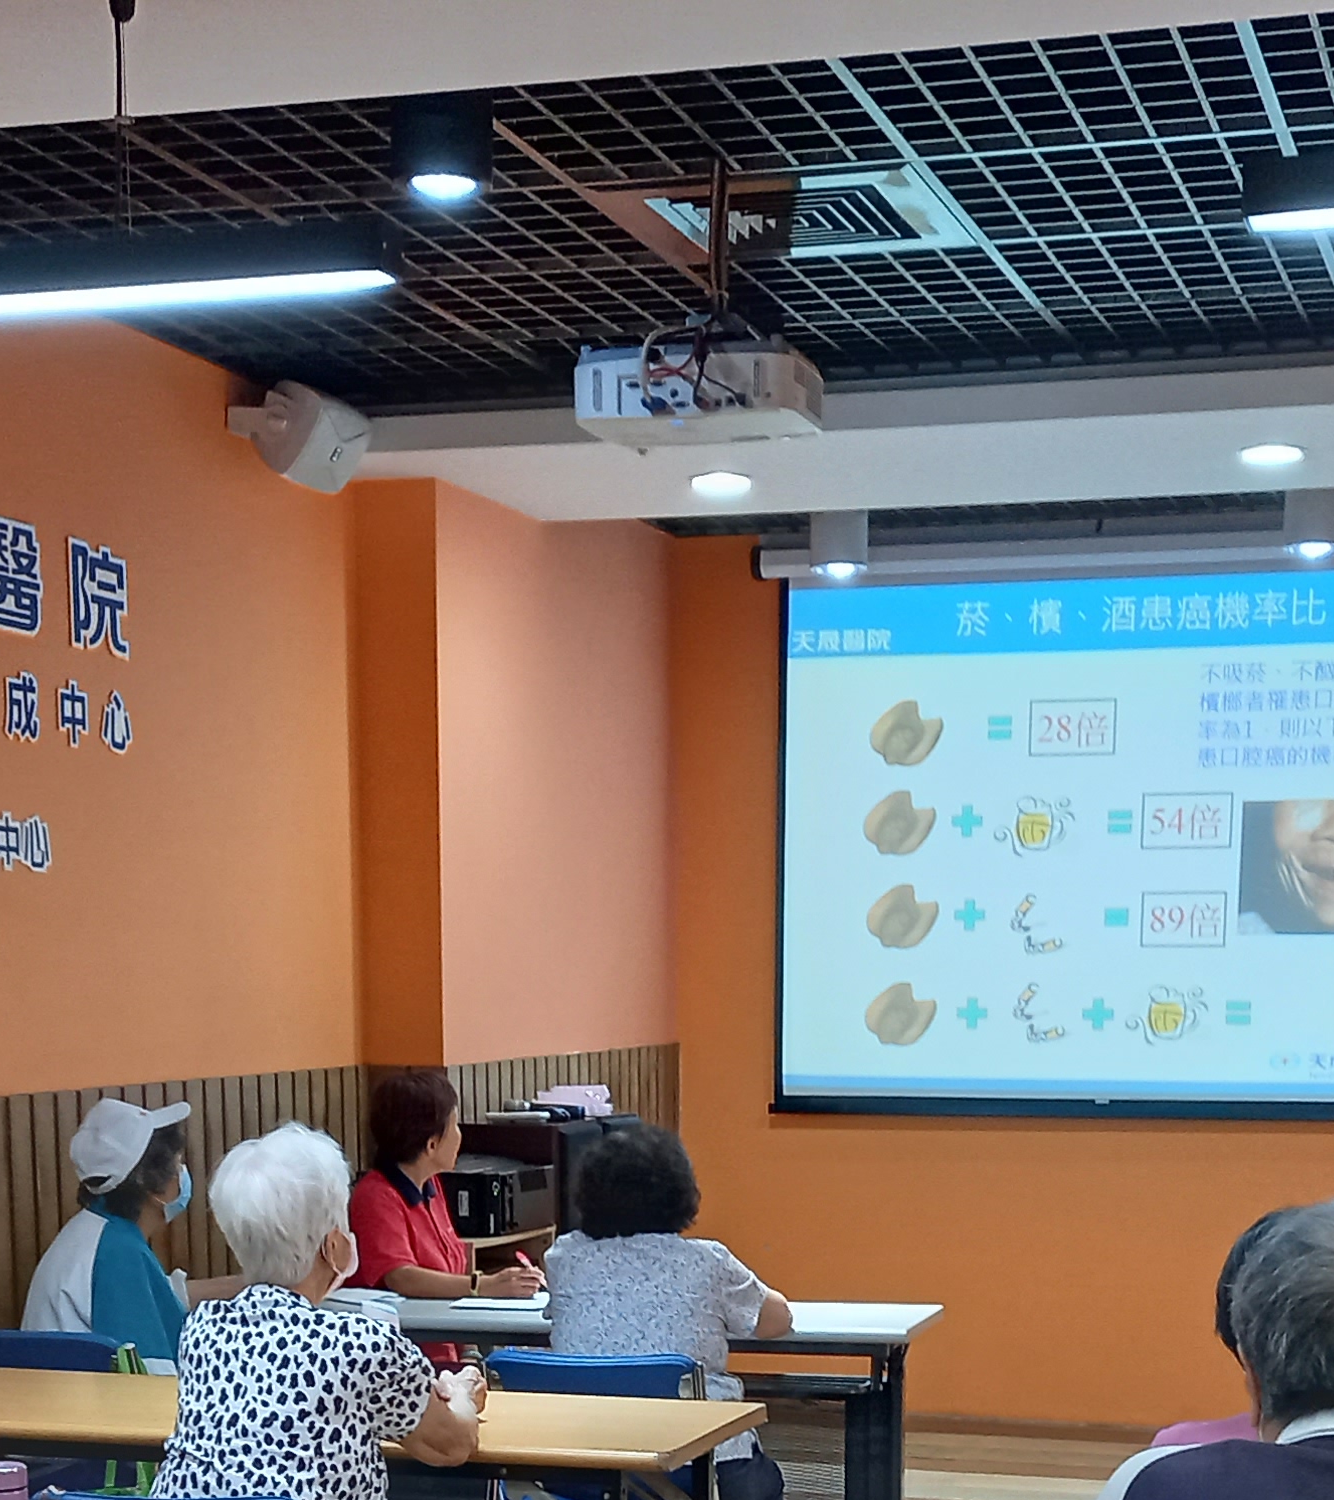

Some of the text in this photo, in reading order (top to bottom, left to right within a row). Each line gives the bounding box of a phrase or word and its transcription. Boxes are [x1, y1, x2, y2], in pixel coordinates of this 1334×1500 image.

[956, 588, 1327, 636] 菸、檳、酒患癌機率比
[791, 628, 892, 652] 天晟醫院
[1038, 711, 1108, 748] 28倍
[1150, 803, 1222, 841] 54倍
[1150, 903, 1220, 939] 89倍
